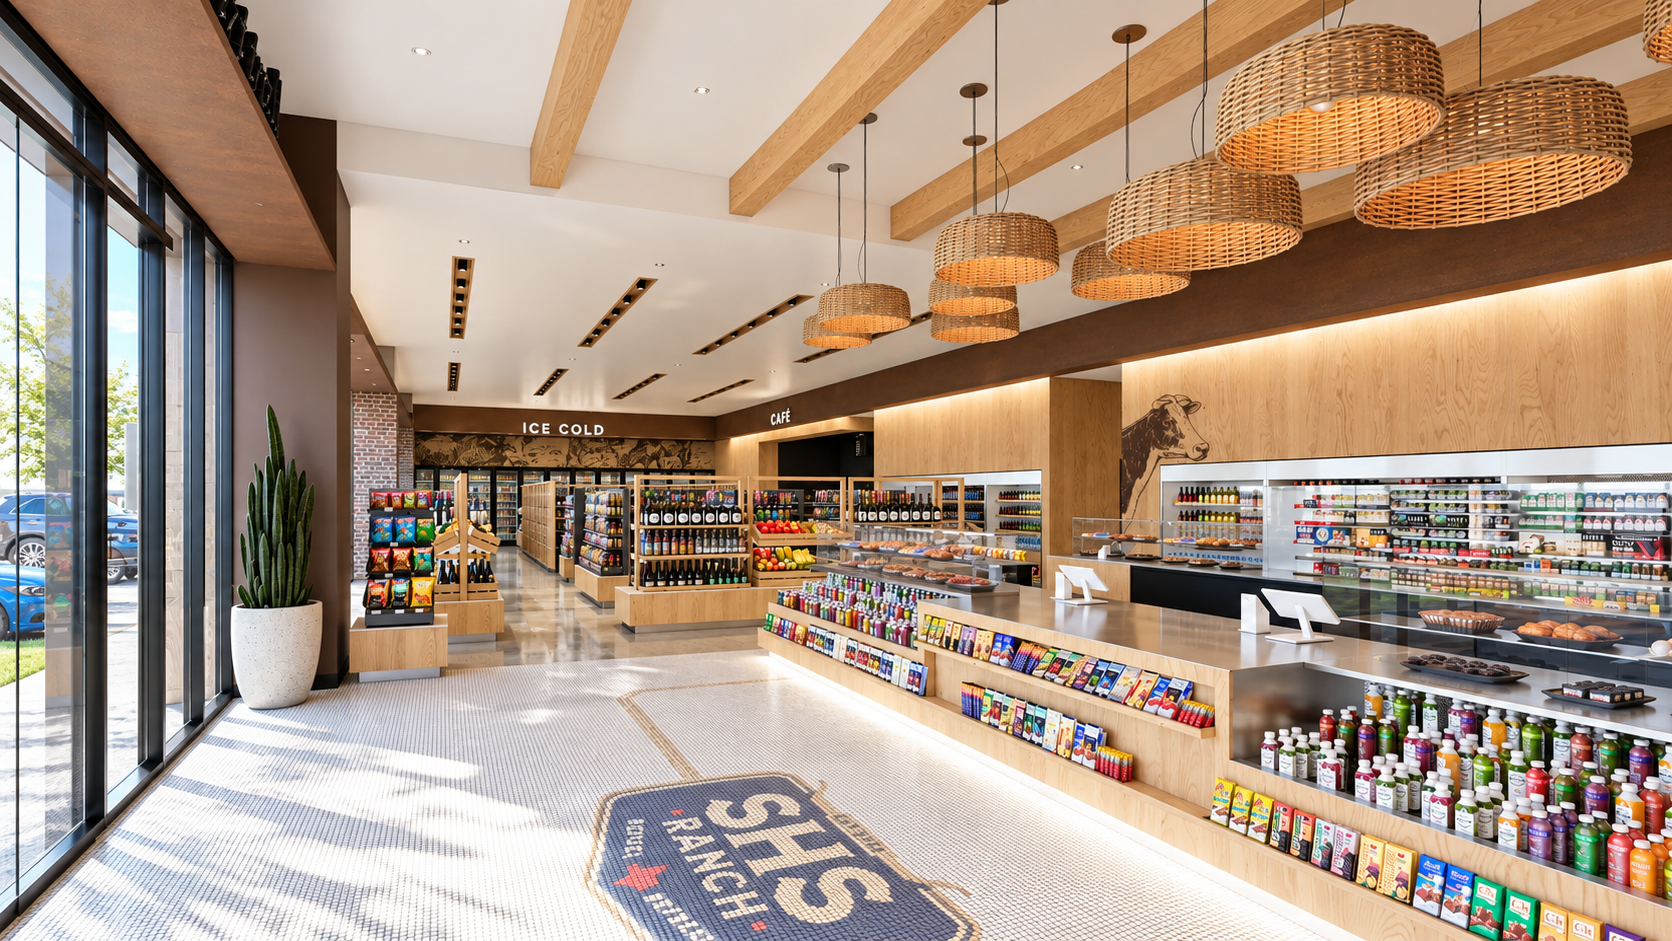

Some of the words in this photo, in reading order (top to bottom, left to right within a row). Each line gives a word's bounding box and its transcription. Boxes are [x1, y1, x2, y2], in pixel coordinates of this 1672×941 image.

[523, 422, 550, 434] ICE
[559, 423, 604, 435] COLD
[771, 408, 790, 425] CAFÉ
[662, 816, 769, 920] RANCH
[705, 793, 894, 924] SHS
